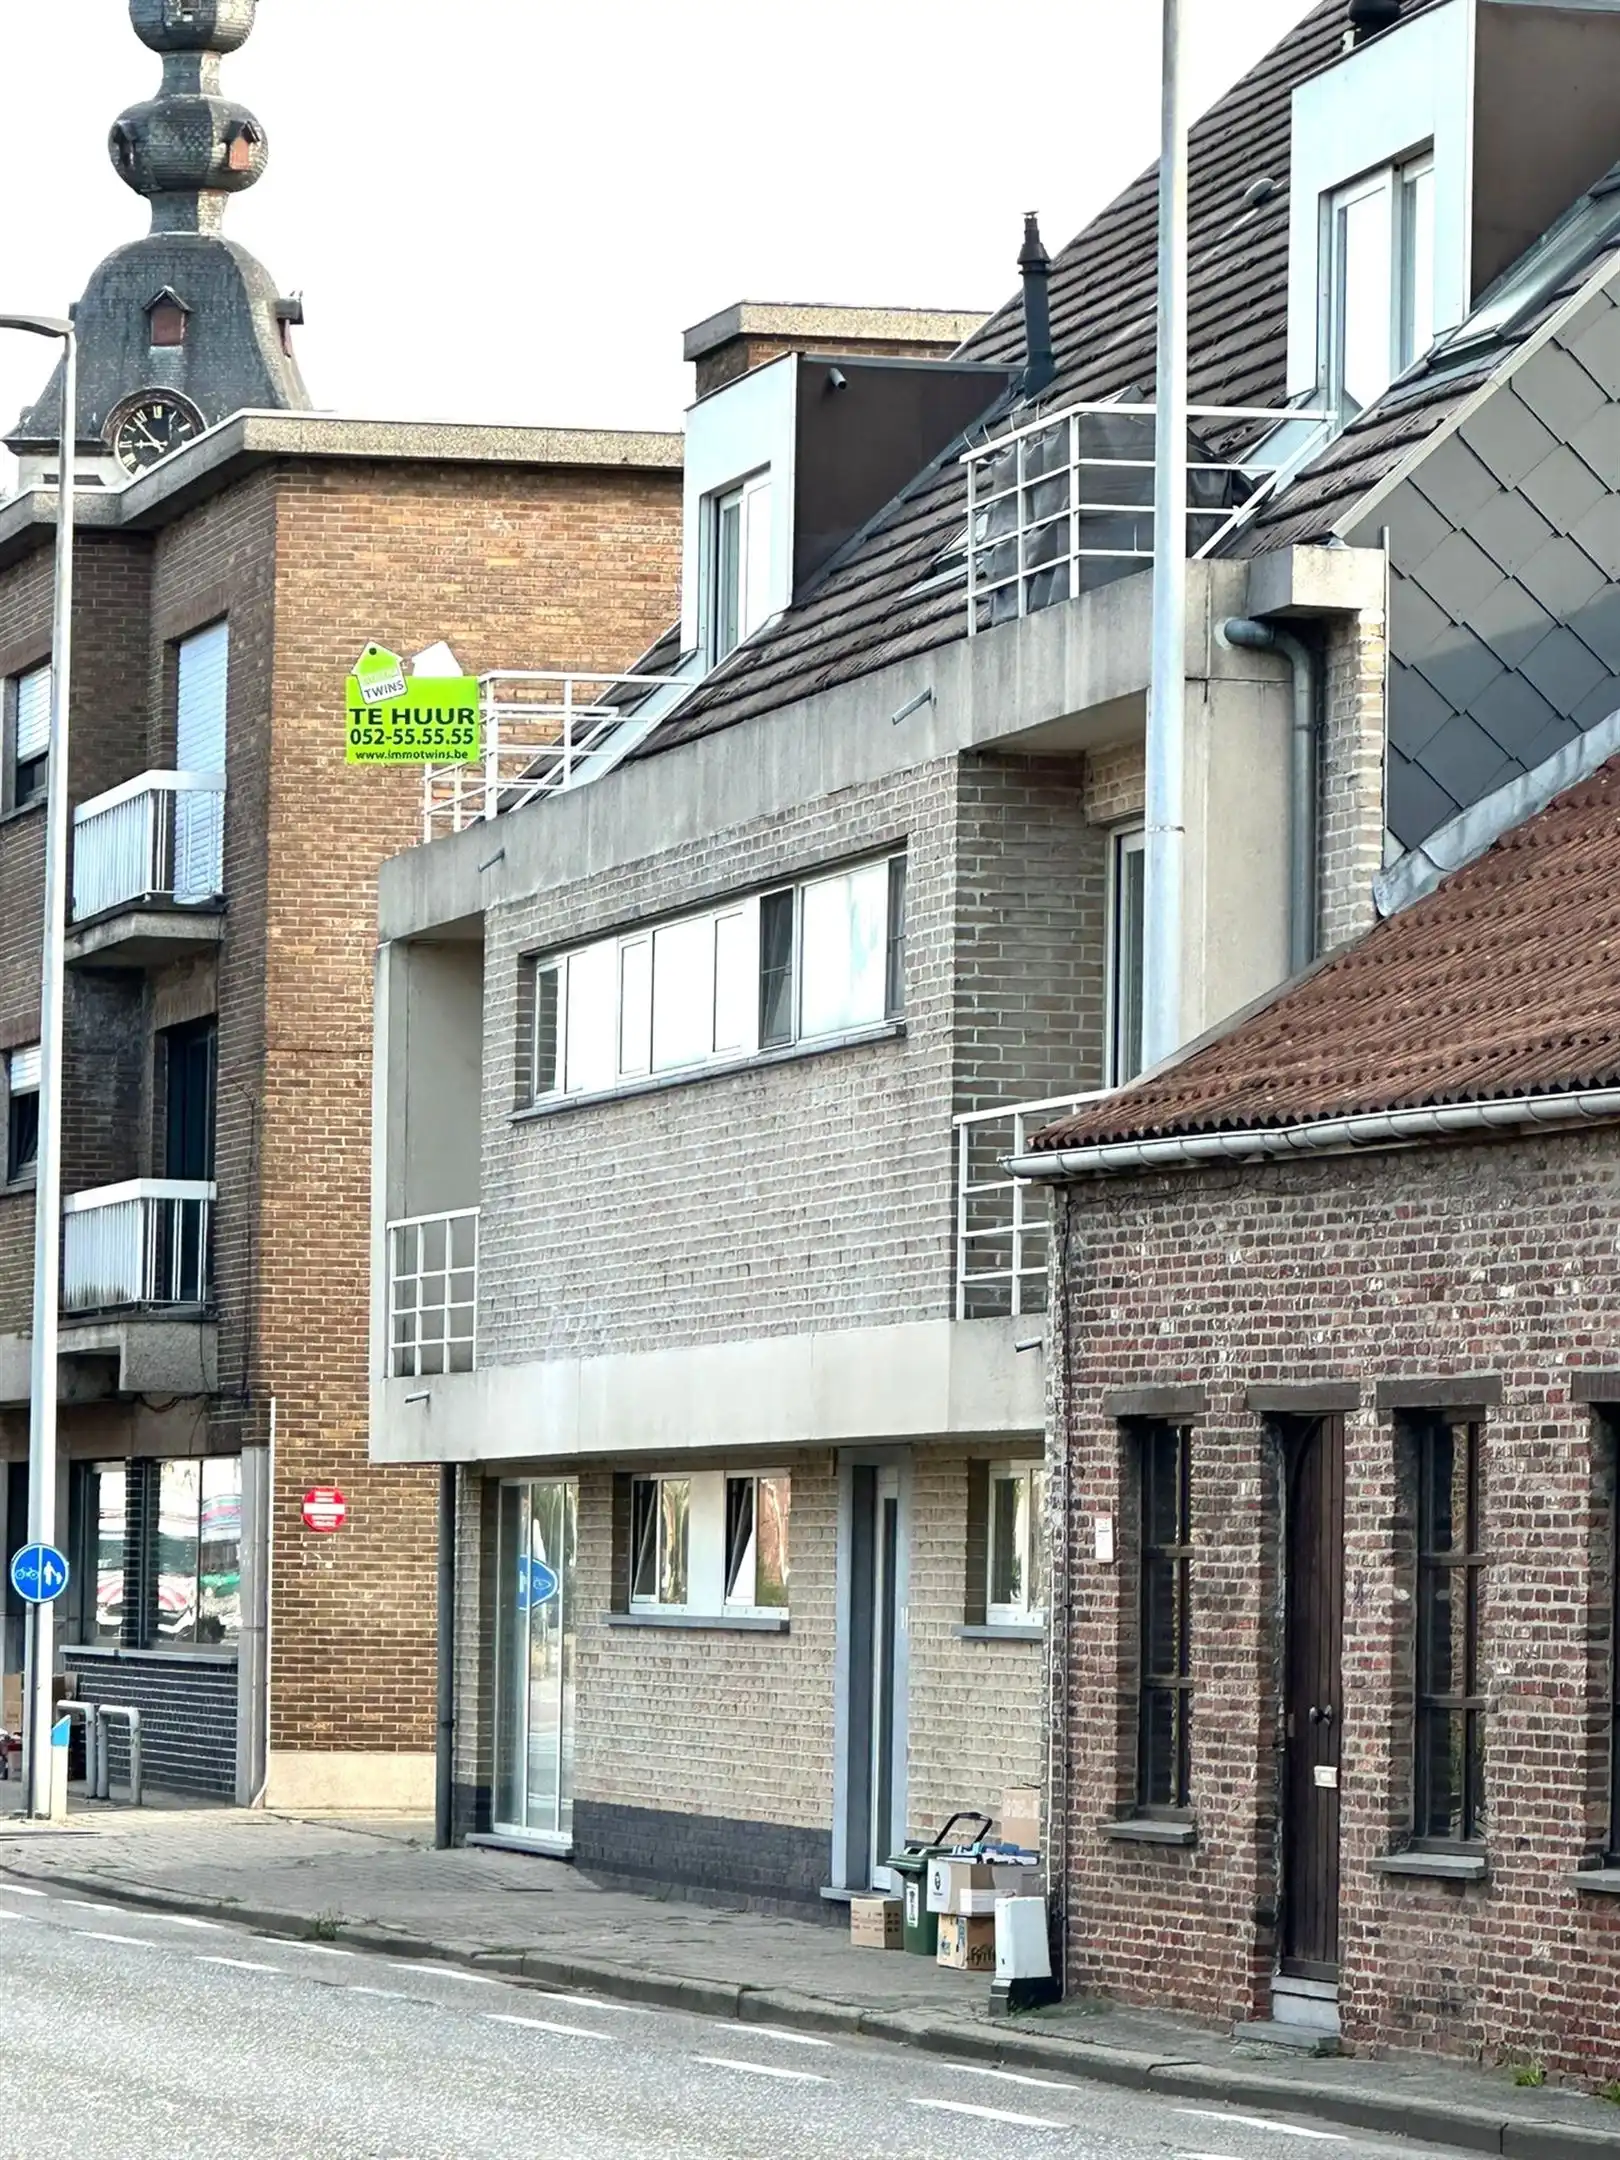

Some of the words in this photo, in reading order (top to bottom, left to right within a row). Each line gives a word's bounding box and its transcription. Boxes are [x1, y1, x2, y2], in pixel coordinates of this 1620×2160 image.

[364, 680, 404, 699] TWINS
[349, 708, 383, 725] TE
[392, 708, 475, 725] HUUR
[350, 728, 474, 745] 052-55.55.55
[355, 749, 469, 759] www.immotwins.be
